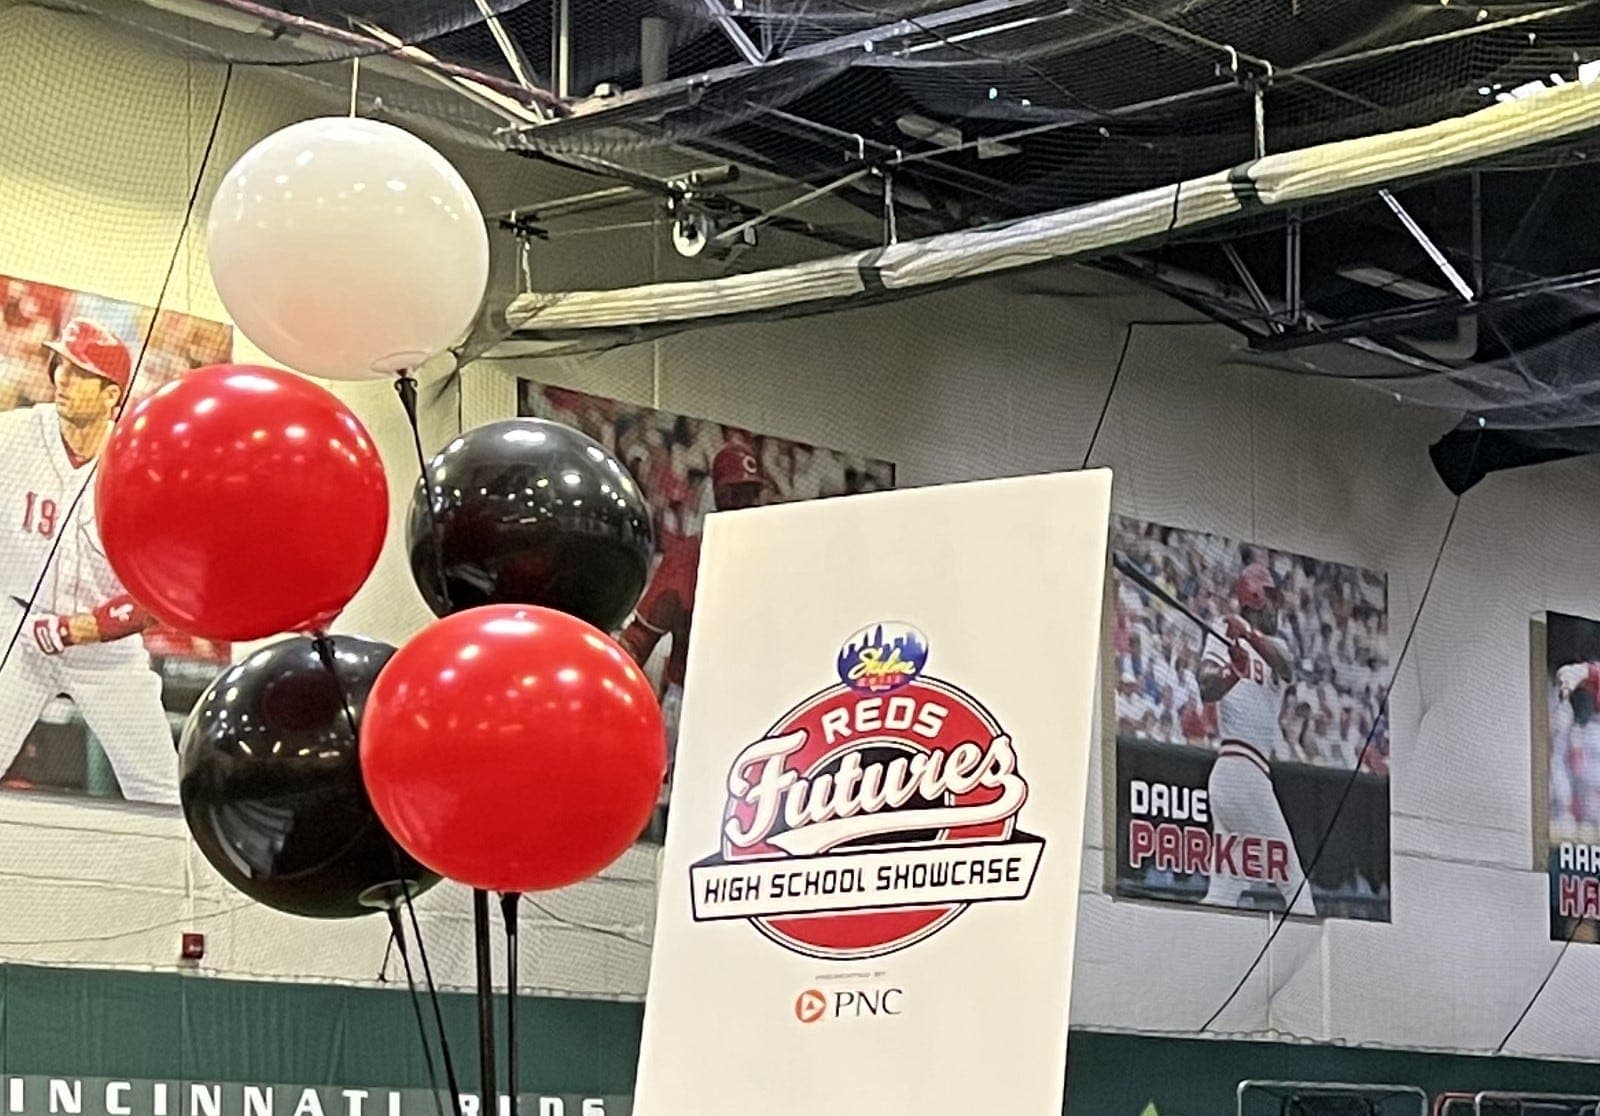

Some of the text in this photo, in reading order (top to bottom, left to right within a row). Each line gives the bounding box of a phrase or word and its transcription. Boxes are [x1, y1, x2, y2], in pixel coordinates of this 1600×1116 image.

[22, 490, 58, 540] 19
[821, 697, 949, 745] REDS
[725, 728, 1027, 849] Futures
[1130, 779, 1209, 823] DAVE
[1129, 818, 1291, 884] PARKER
[704, 857, 1022, 903] HIGH SCHOOL SHOWCASE
[834, 988, 903, 1018] PNC
